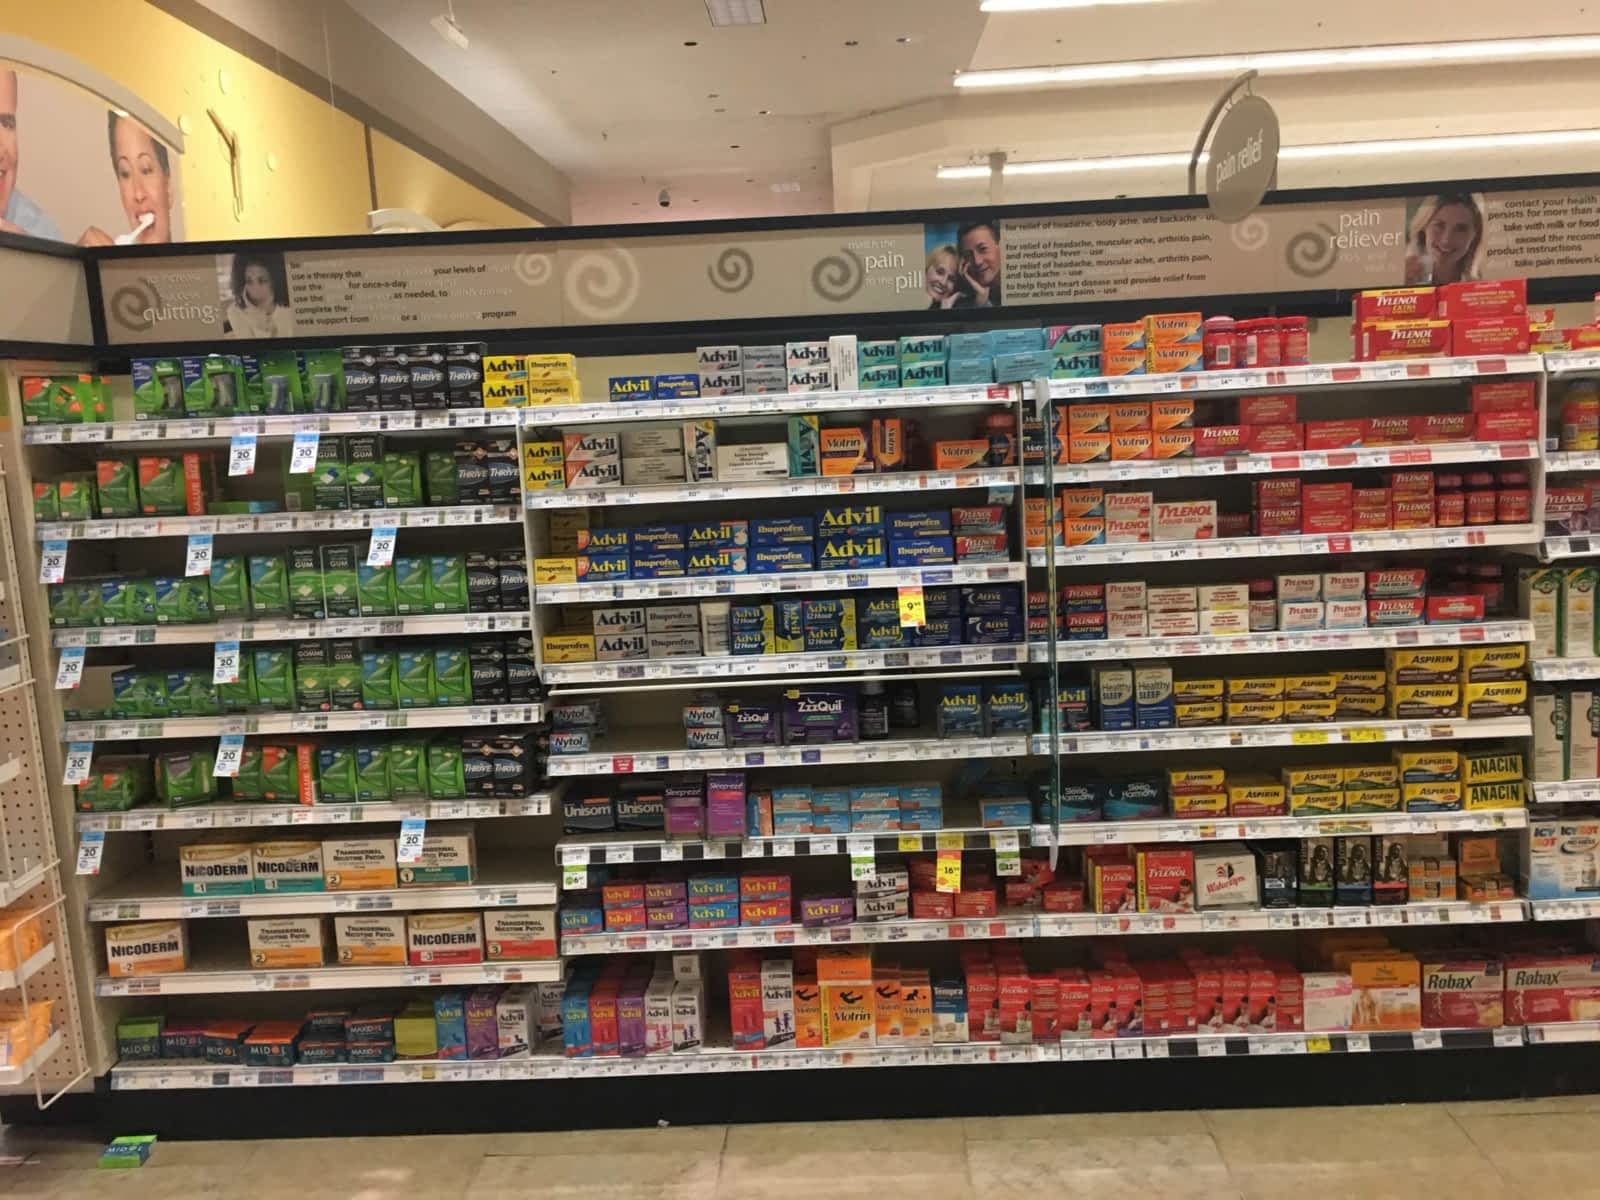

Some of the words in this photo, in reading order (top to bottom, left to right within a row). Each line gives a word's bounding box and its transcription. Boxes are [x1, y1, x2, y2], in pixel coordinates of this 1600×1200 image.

[1216, 152, 1235, 192] pain
[1237, 128, 1263, 172] relief
[1505, 200, 1539, 208] contact
[1543, 199, 1564, 208] your
[1568, 196, 1597, 204] health
[1488, 211, 1523, 221] persists
[1544, 209, 1568, 217] more
[1571, 207, 1592, 215] than
[1340, 209, 1380, 232] pain
[1504, 223, 1522, 231] take
[1525, 222, 1544, 230] with
[1054, 240, 1092, 249] headache,
[1096, 238, 1133, 246] muscular
[1158, 235, 1189, 243] arthritis
[1192, 234, 1212, 243] pain,
[1330, 231, 1402, 248] reliever
[1549, 234, 1564, 242] the
[1487, 247, 1523, 256] product
[1527, 244, 1581, 254] instructions
[865, 251, 904, 272] pain
[1023, 252, 1058, 260] reducing
[1536, 259, 1555, 267] pain
[1557, 256, 1592, 264] relievers
[314, 272, 343, 280] therapy
[433, 266, 452, 275] your
[453, 265, 475, 273] levels
[363, 280, 407, 289] once-a-day
[895, 271, 922, 293] pill
[1017, 283, 1034, 291] help
[1037, 281, 1055, 290] fight
[1058, 280, 1079, 288] heart
[1082, 279, 1111, 287] disease
[1131, 276, 1160, 285] provide
[1163, 274, 1184, 282] relief
[1187, 273, 1206, 281] from
[404, 291, 436, 299] needed,
[1074, 289, 1095, 298] pains
[1377, 296, 1417, 306] TYLENOL
[316, 316, 347, 325] support
[482, 310, 517, 320] program
[1062, 329, 1098, 343] Advil
[1391, 330, 1433, 340] TYLENOL
[700, 349, 737, 363] Advil
[789, 346, 828, 359] Advil
[486, 360, 525, 373] Advil
[531, 361, 566, 369] Ibuprofen
[905, 366, 943, 380] Advil
[346, 376, 375, 384] THRIVE
[702, 374, 740, 388] Advil
[612, 379, 650, 393] Advil
[1159, 407, 1190, 415] Motrin
[1427, 416, 1464, 425] TYLENOL
[1203, 428, 1240, 438] TYLENOL
[577, 438, 615, 451] Advil
[827, 438, 860, 447] Motrin
[943, 448, 973, 456] Motrin
[579, 464, 617, 477] Advil
[820, 506, 880, 527] Advil
[1157, 506, 1212, 517] TYLENOL
[758, 524, 804, 533] Ibuprofen
[1108, 521, 1148, 530] TYLENOL
[635, 533, 678, 542] Ibuprofen
[691, 526, 730, 540] Advil
[590, 533, 627, 546] Advil
[898, 546, 943, 555] Ibuprofen
[47, 558, 59, 566] 20
[757, 552, 801, 561] Ibuprofen
[470, 577, 498, 586] THRIVE
[1378, 602, 1415, 611] TYLENOL
[596, 610, 641, 625] Advil
[546, 642, 592, 651] Ibuprofen
[600, 636, 644, 651] Advil
[221, 658, 232, 666] 20
[1412, 655, 1453, 664] ASPIRIN
[1484, 652, 1521, 661] ASPIRIN
[1138, 680, 1170, 691] Healthy
[1139, 691, 1160, 699] SLEEP
[1412, 689, 1454, 697] ASPIRIN
[1483, 688, 1521, 696] ASPIRIN
[798, 700, 841, 712] ZzzQuil
[941, 695, 976, 706] Advil
[556, 736, 583, 748] Nytol
[693, 731, 719, 742] Nytol
[1416, 757, 1452, 765] ASPIRIN
[1471, 757, 1519, 773] ANACIN
[465, 764, 492, 772] THRIVE
[1184, 773, 1213, 781] ASPIRIN
[1472, 784, 1519, 801] ANACIN
[565, 805, 610, 817] Unisom
[618, 803, 663, 815] Unisom
[1561, 826, 1577, 835] ICY
[1149, 869, 1186, 878] TYLENOL
[692, 884, 723, 894] Advil
[865, 878, 896, 890] Advil
[564, 916, 588, 924] Advil
[413, 933, 476, 946] NICODERM
[112, 942, 178, 957] NICODERM
[1428, 974, 1475, 989] Robax
[1515, 970, 1561, 986] Robax
[935, 987, 963, 997] Tempra
[834, 1011, 870, 1021] Motrin
[121, 1045, 157, 1054] MIDOL
[251, 1046, 286, 1055] MIDOL
